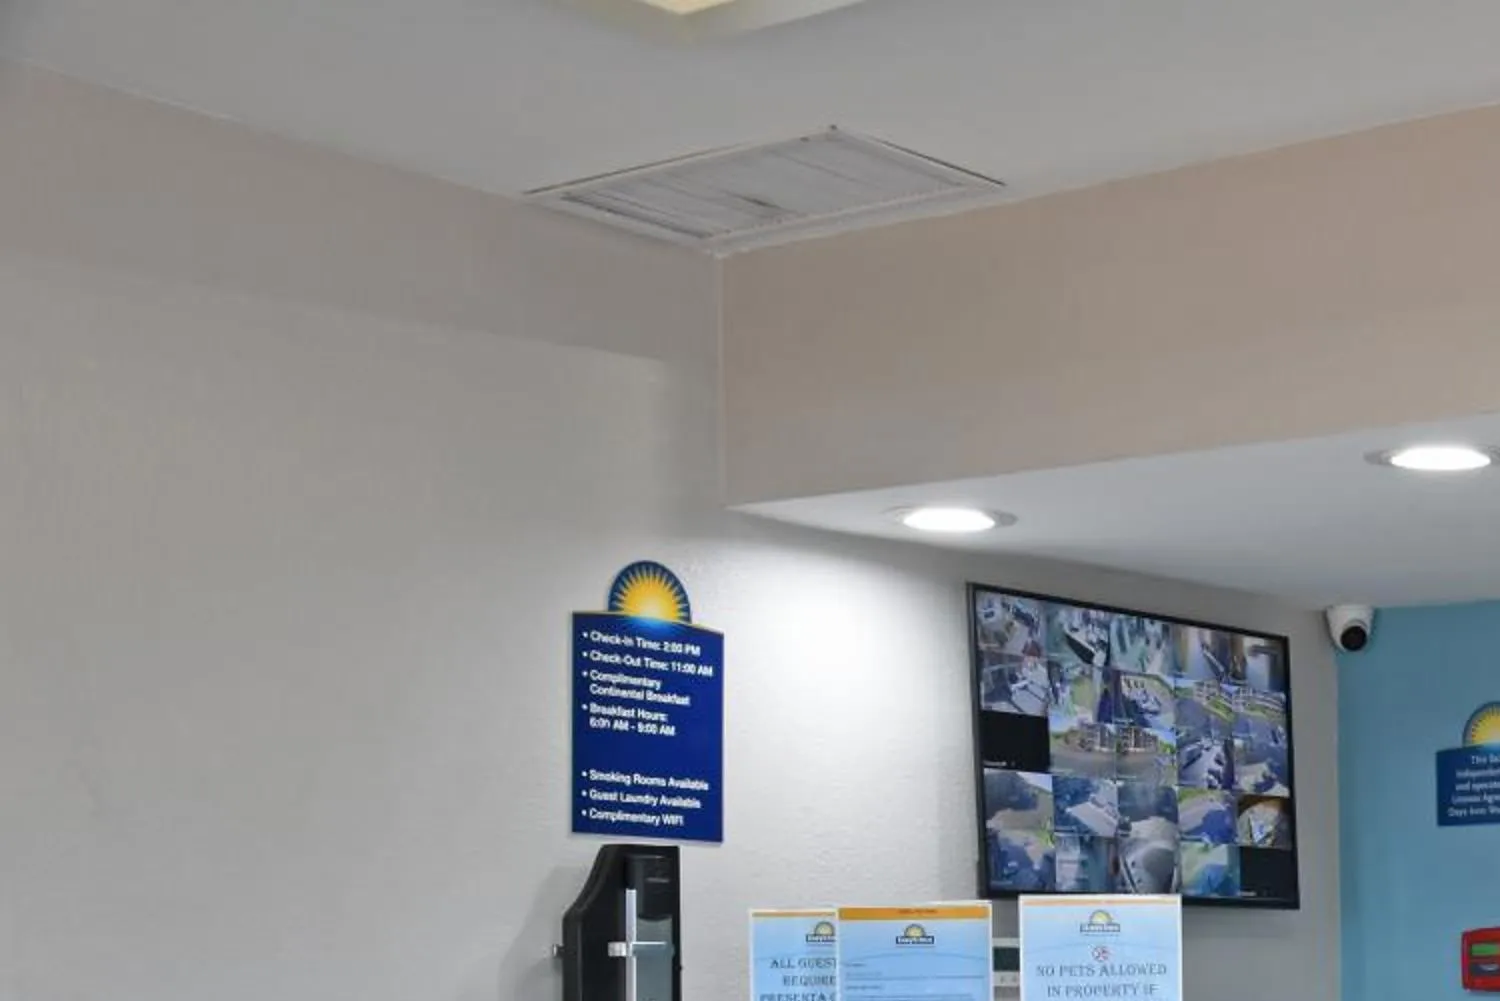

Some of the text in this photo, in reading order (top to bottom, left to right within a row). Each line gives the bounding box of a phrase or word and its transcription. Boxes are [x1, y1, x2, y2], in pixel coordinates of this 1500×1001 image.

[770, 958, 796, 969] ALL
[1036, 963, 1167, 977] NO PETS ALLOWED
[1047, 983, 1160, 998] IN PROPERTY IF
